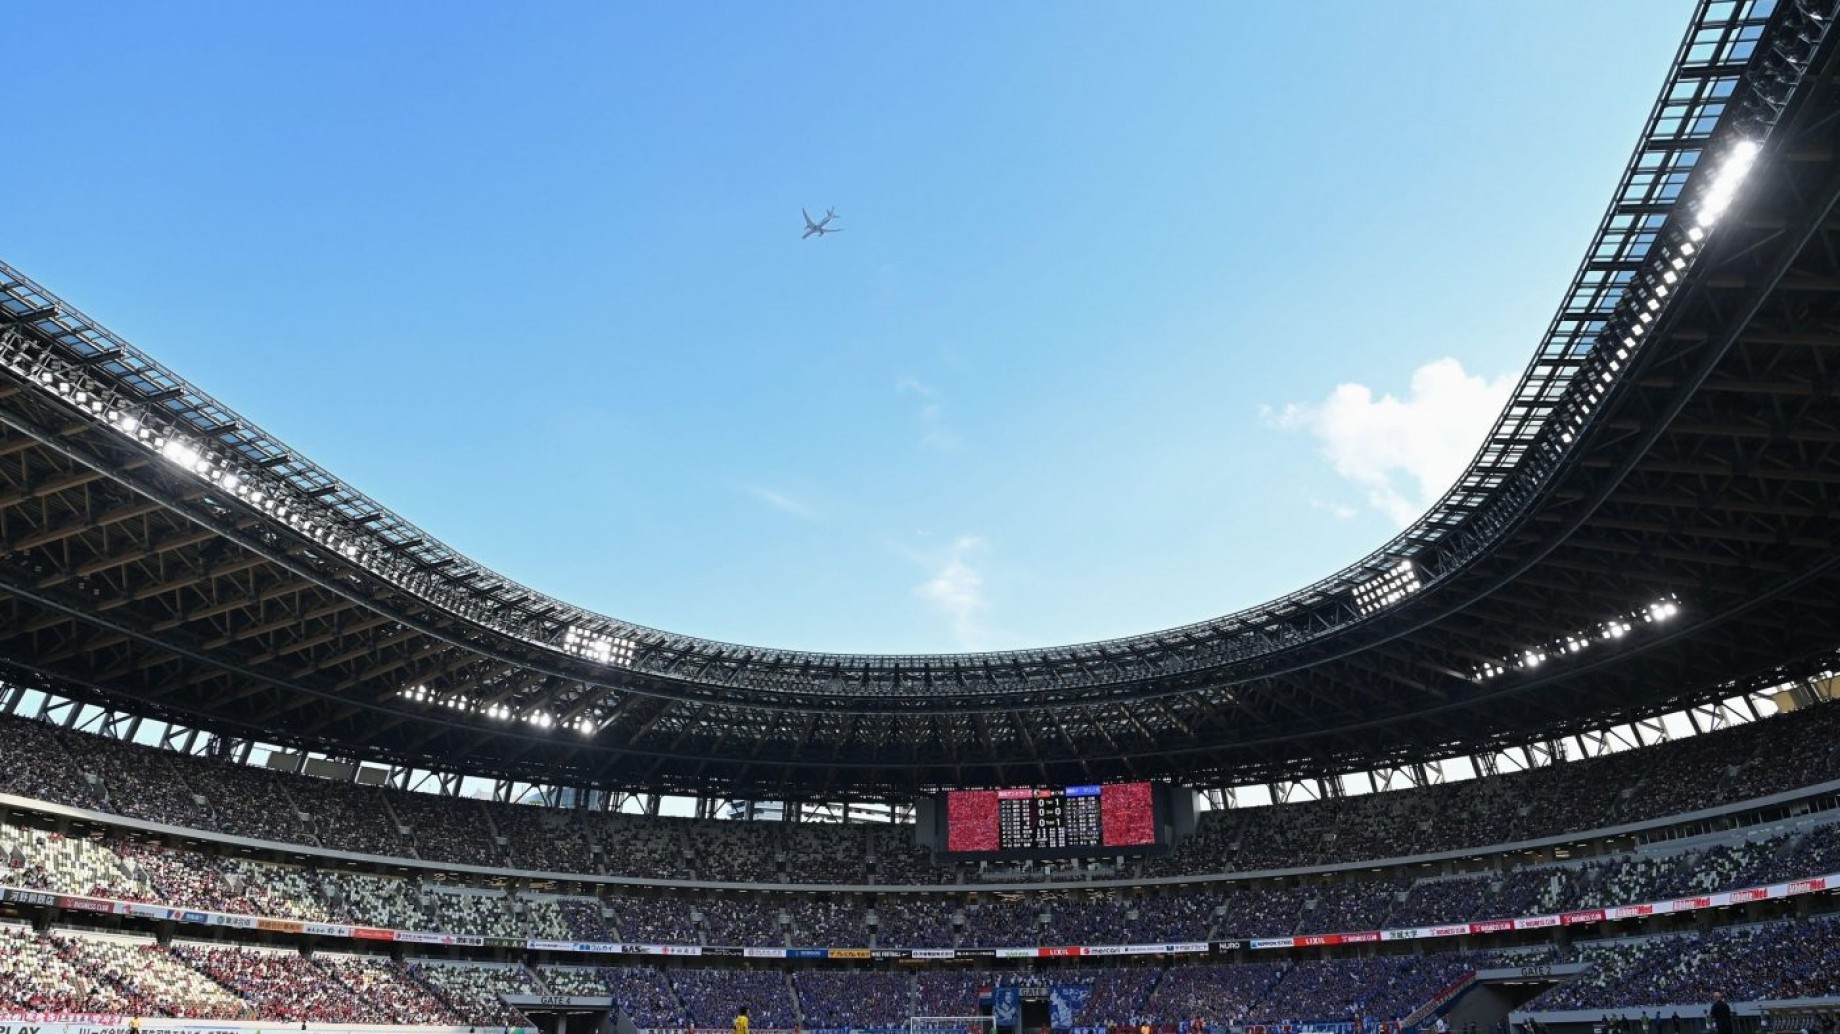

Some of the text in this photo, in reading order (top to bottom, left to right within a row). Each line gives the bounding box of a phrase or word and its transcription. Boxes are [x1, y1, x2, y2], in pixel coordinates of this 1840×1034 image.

[1055, 798, 1059, 806] 1
[1038, 808, 1045, 816] 0
[1055, 807, 1061, 815] 0
[1039, 818, 1045, 826] 0
[1055, 818, 1060, 826] 1
[1305, 937, 1326, 945] LIXIL
[1522, 966, 1545, 976] GATE
[541, 996, 564, 1005] GATE
